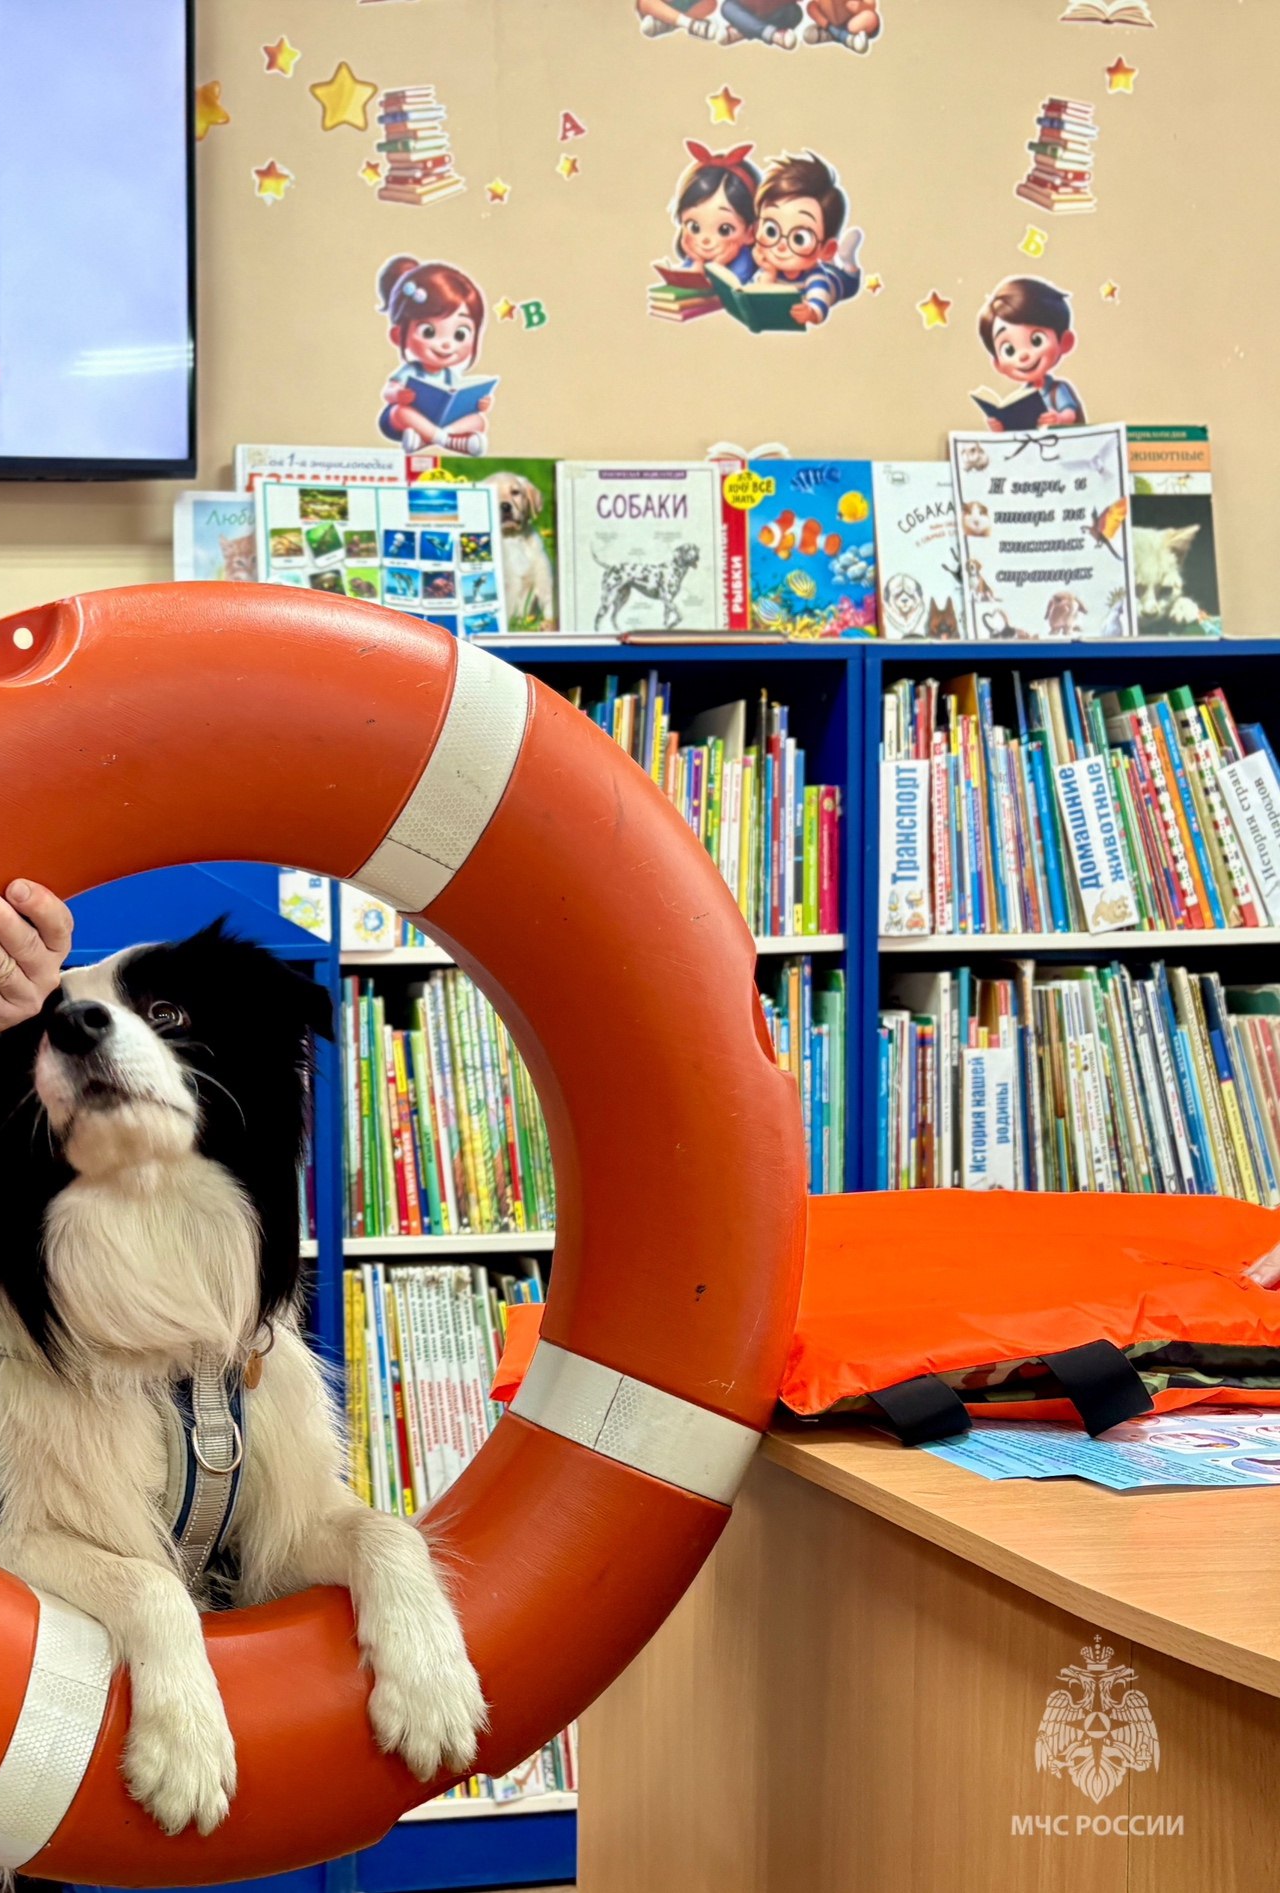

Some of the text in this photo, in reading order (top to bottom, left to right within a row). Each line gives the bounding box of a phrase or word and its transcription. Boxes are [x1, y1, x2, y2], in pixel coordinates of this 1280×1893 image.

[1019, 227, 1047, 257] Б
[1131, 449, 1205, 462] животные
[596, 493, 688, 519] СОБАКИ
[988, 477, 1005, 495] И
[1074, 477, 1087, 491] и
[1062, 507, 1086, 521] на
[998, 537, 1085, 553] книжных
[731, 555, 743, 614] РЫБКИ
[995, 565, 1094, 586] страницах
[890, 765, 922, 884] Транспорт
[1058, 766, 1104, 891] Домашние
[1086, 761, 1127, 883] животные
[1226, 768, 1277, 882] История стран
[969, 1056, 986, 1174] История нашей
[996, 1082, 1011, 1145] родины
